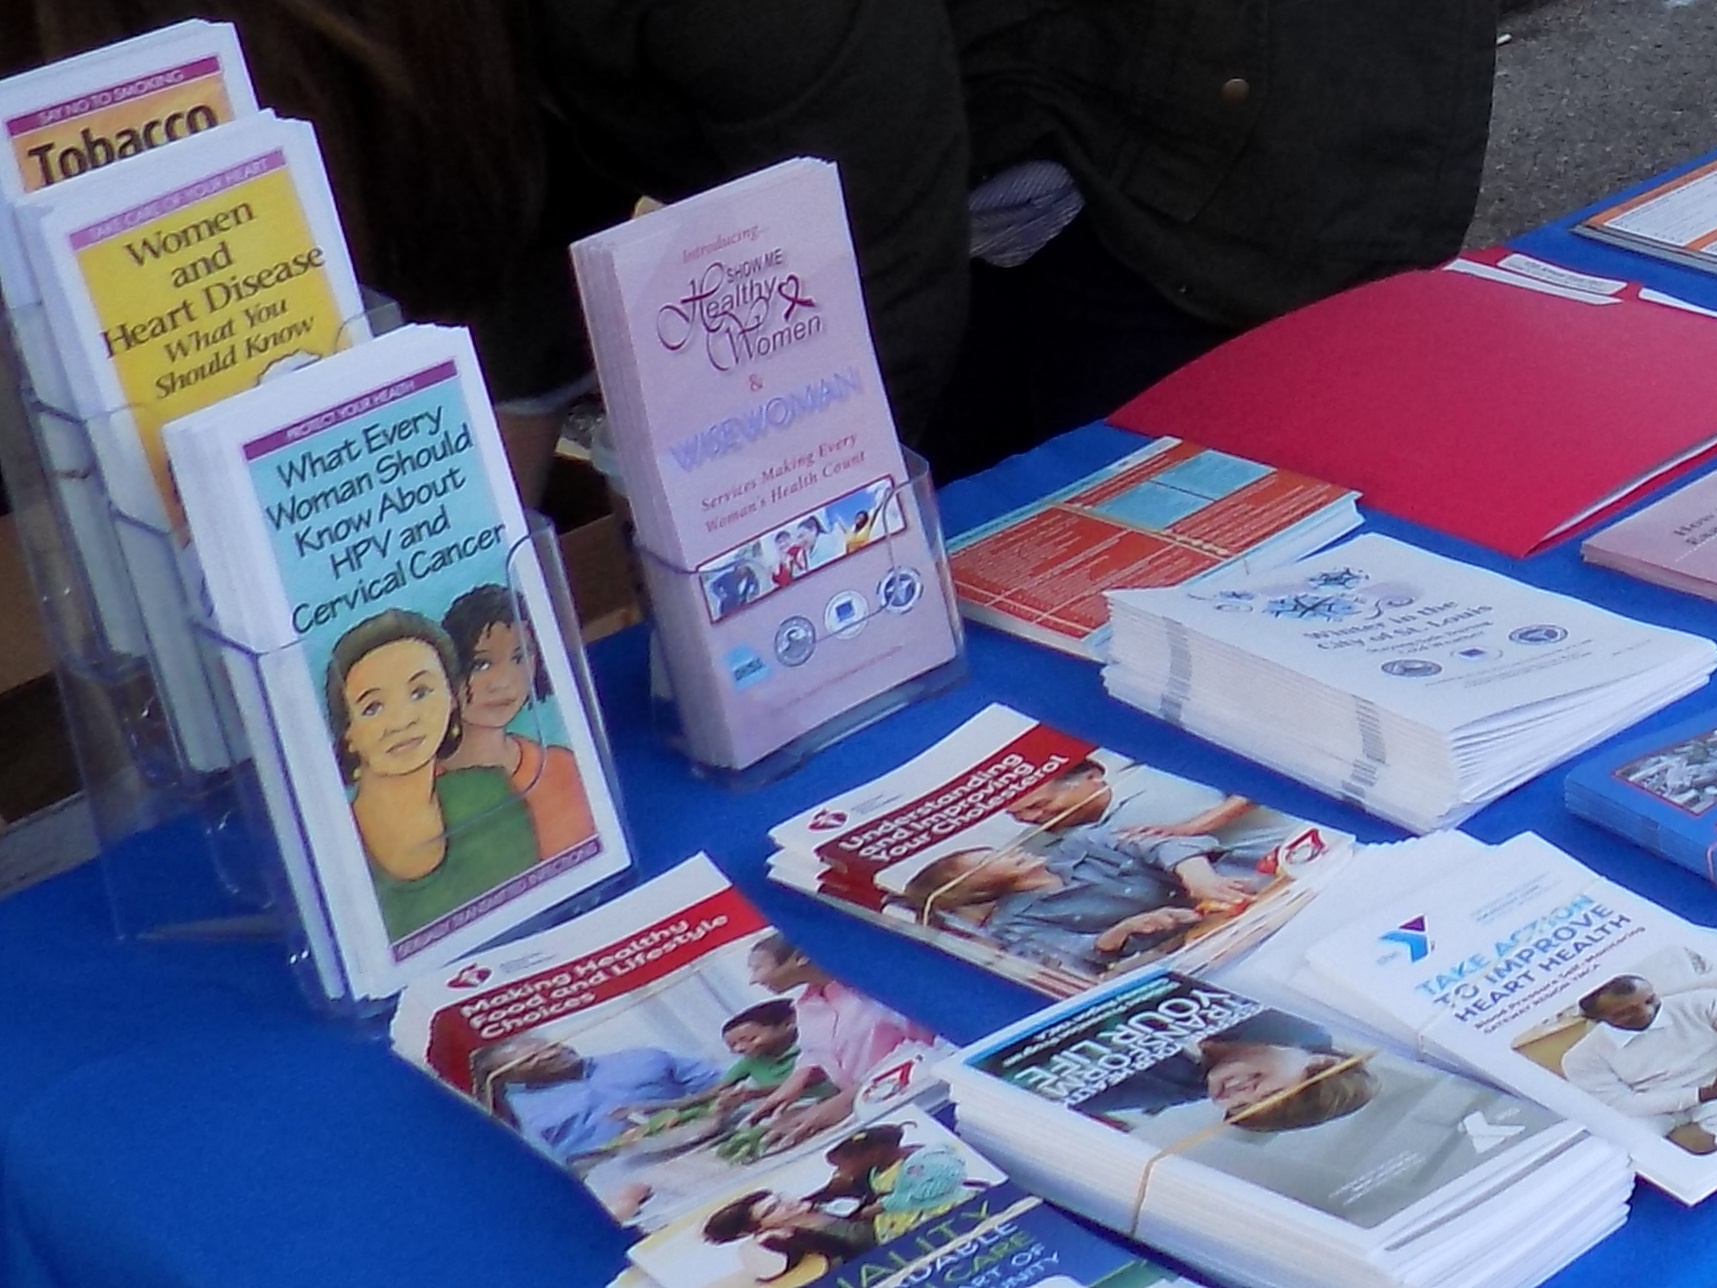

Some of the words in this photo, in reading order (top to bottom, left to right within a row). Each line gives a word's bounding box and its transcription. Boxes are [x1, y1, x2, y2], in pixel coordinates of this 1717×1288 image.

[28, 104, 220, 187] Tobacco
[124, 201, 257, 267] Women
[171, 241, 234, 288] and
[727, 255, 763, 285] SHOW
[763, 247, 785, 270] ME
[102, 299, 199, 358] Heart
[202, 246, 326, 314] Disease
[163, 319, 236, 363] What
[243, 298, 288, 328] You
[656, 261, 778, 351] Healthy
[706, 296, 823, 372] Women
[155, 345, 238, 401] Should
[243, 316, 315, 359] Know
[749, 374, 763, 393] &
[265, 472, 374, 531] Woman
[375, 422, 474, 485] Should
[276, 439, 361, 489] What
[361, 406, 443, 455] Every
[700, 477, 758, 514] Services
[761, 450, 816, 482] Making
[818, 432, 859, 459] Every
[294, 508, 373, 558] Know
[377, 467, 466, 522] About
[705, 494, 769, 534] Woman's
[770, 472, 819, 504] Health
[822, 449, 866, 479] Count
[292, 560, 407, 635] Cervical
[409, 522, 506, 581] Cancer
[329, 528, 392, 579] HPV
[400, 504, 451, 551] and
[839, 753, 1026, 852] Understanding
[858, 826, 910, 859] and
[908, 762, 1036, 835] Improving
[870, 834, 932, 863] Your
[931, 754, 1070, 838] Cholesterol
[460, 969, 574, 1017] Making
[573, 919, 691, 977] Healthy
[469, 994, 546, 1030] Food
[549, 965, 612, 998] and
[611, 914, 729, 977] Lifestyle
[1414, 952, 1492, 997] TAKE
[1493, 892, 1596, 954] ACTION
[1434, 982, 1481, 1009] TO
[1485, 902, 1614, 984] IMPROVE
[1454, 969, 1540, 1024] HEART
[1537, 913, 1633, 973] HEALTH
[478, 990, 597, 1039] Choices
[1042, 999, 1243, 1100] TRANSFORM
[1095, 989, 1233, 1043] YOUR
[1012, 1039, 1112, 1092] LIFE
